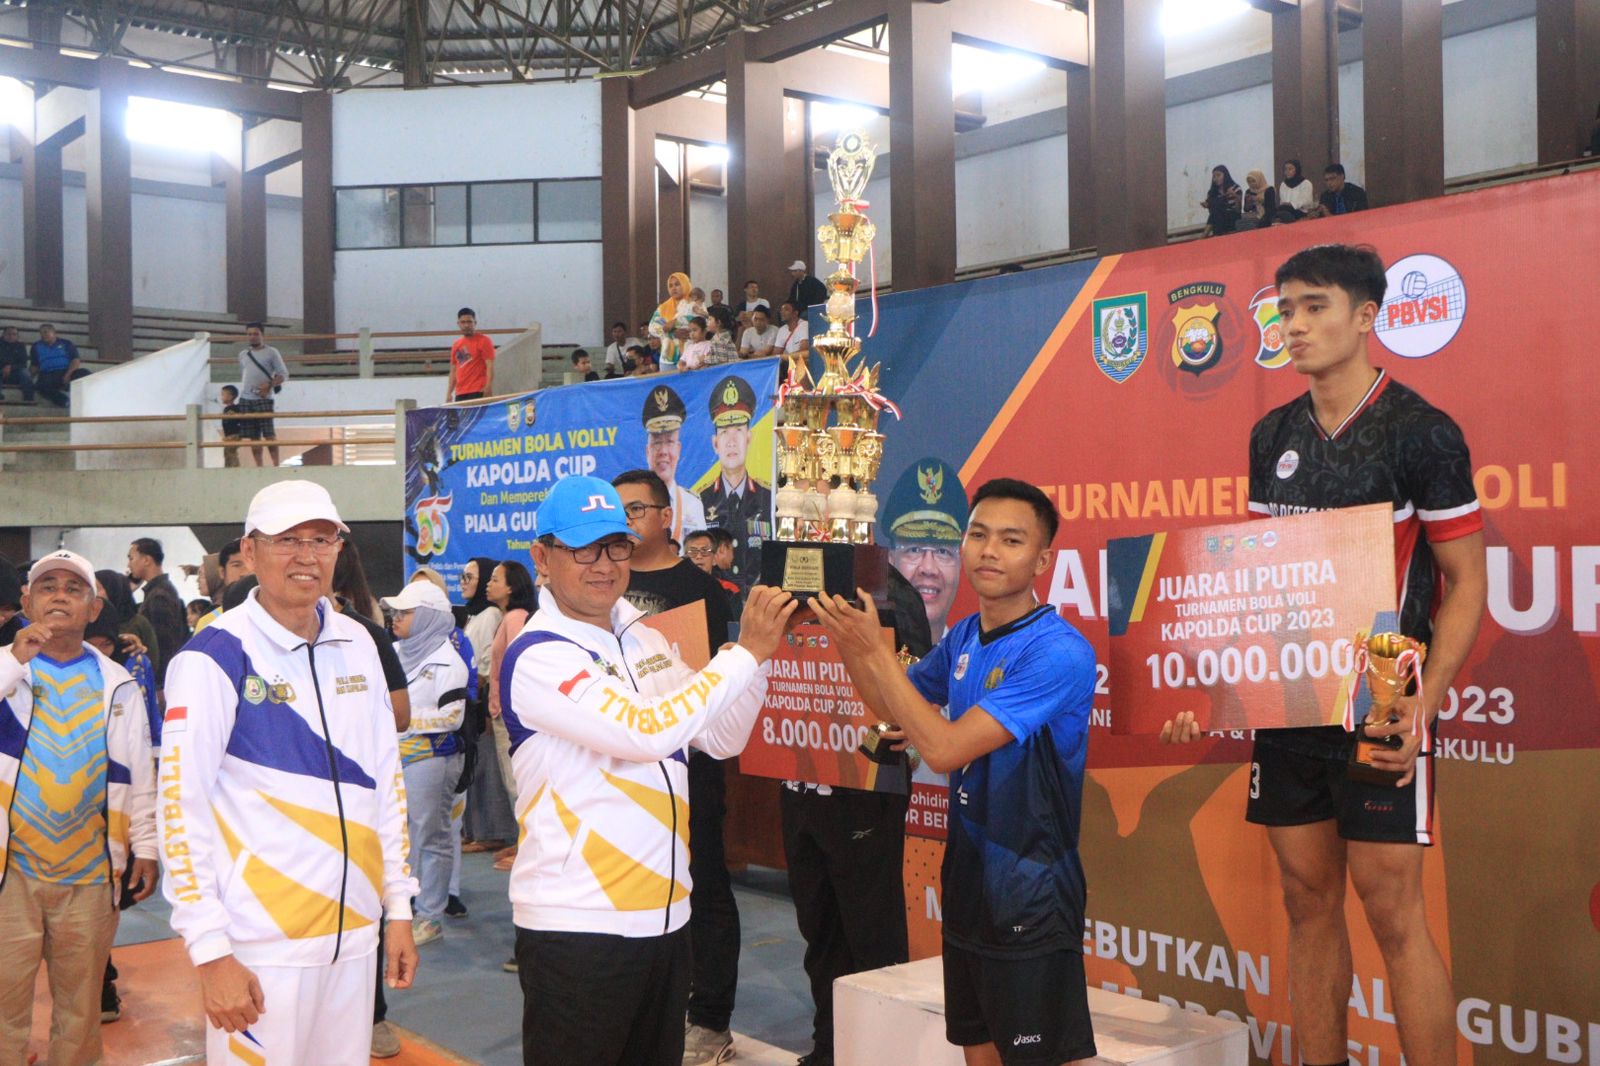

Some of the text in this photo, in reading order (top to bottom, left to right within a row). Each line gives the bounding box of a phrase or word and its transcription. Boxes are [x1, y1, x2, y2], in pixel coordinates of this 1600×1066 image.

[1171, 285, 1222, 302] BENGKULU
[1387, 295, 1449, 328] PBVSI
[451, 427, 618, 461] TURNAMEN BOLA VOLLY
[466, 455, 597, 488] KAPOLDA CUP
[1473, 462, 1566, 509] OLI
[480, 492, 498, 506] Dan
[464, 513, 507, 533] PIALA
[1157, 559, 1337, 602] JUARA II PUTRA
[1175, 590, 1316, 617] TURNAMEN BOLA VOLI
[1161, 608, 1335, 641] KAPOLDA CUP 2023
[802, 661, 817, 680] III
[1146, 638, 1354, 688] 10.000.000
[772, 681, 853, 698] TURNAMEN BOLA VOLI
[765, 694, 864, 717] KAPOLDA CUP 2023
[1438, 685, 1515, 725] 023
[911, 792, 949, 809] ohidin
